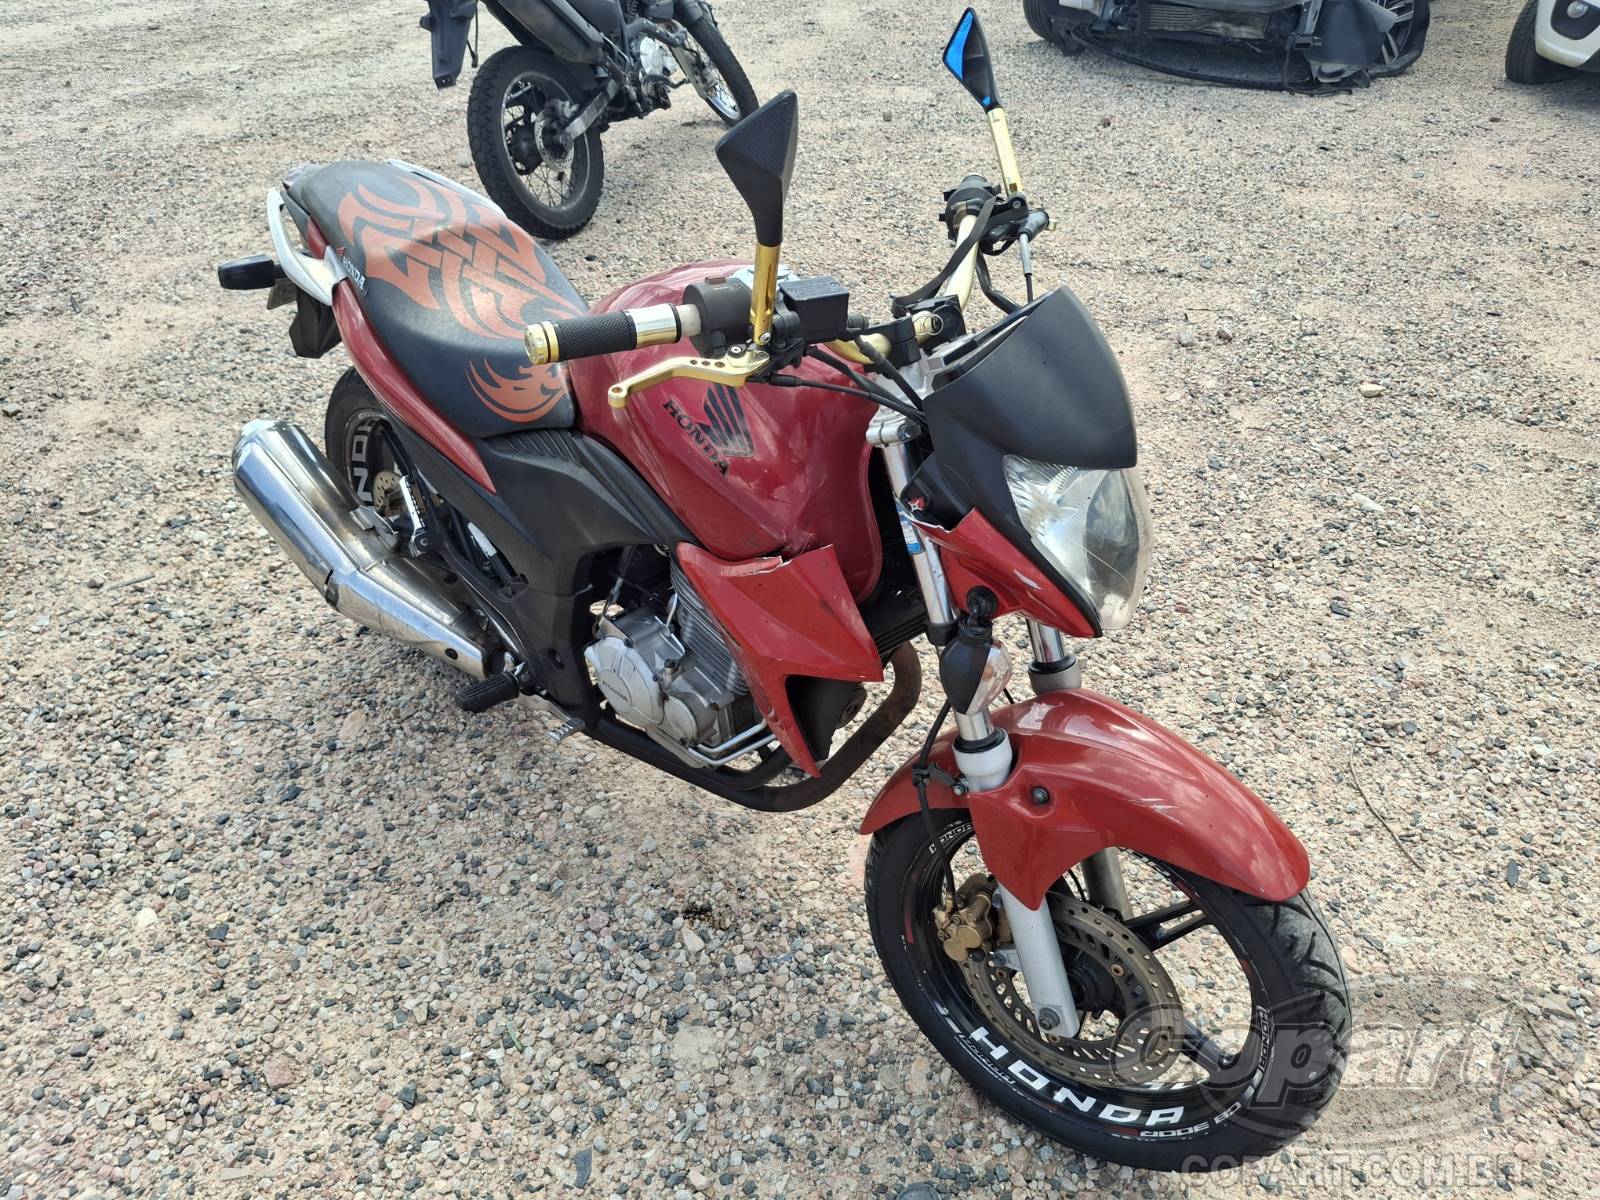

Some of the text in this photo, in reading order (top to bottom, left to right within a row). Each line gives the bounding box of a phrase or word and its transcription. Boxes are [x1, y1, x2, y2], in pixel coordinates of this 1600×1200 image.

[662, 398, 729, 476] HONDA
[970, 1026, 1185, 1126] HONDA
[1139, 1101, 1242, 1137] CB 300R
